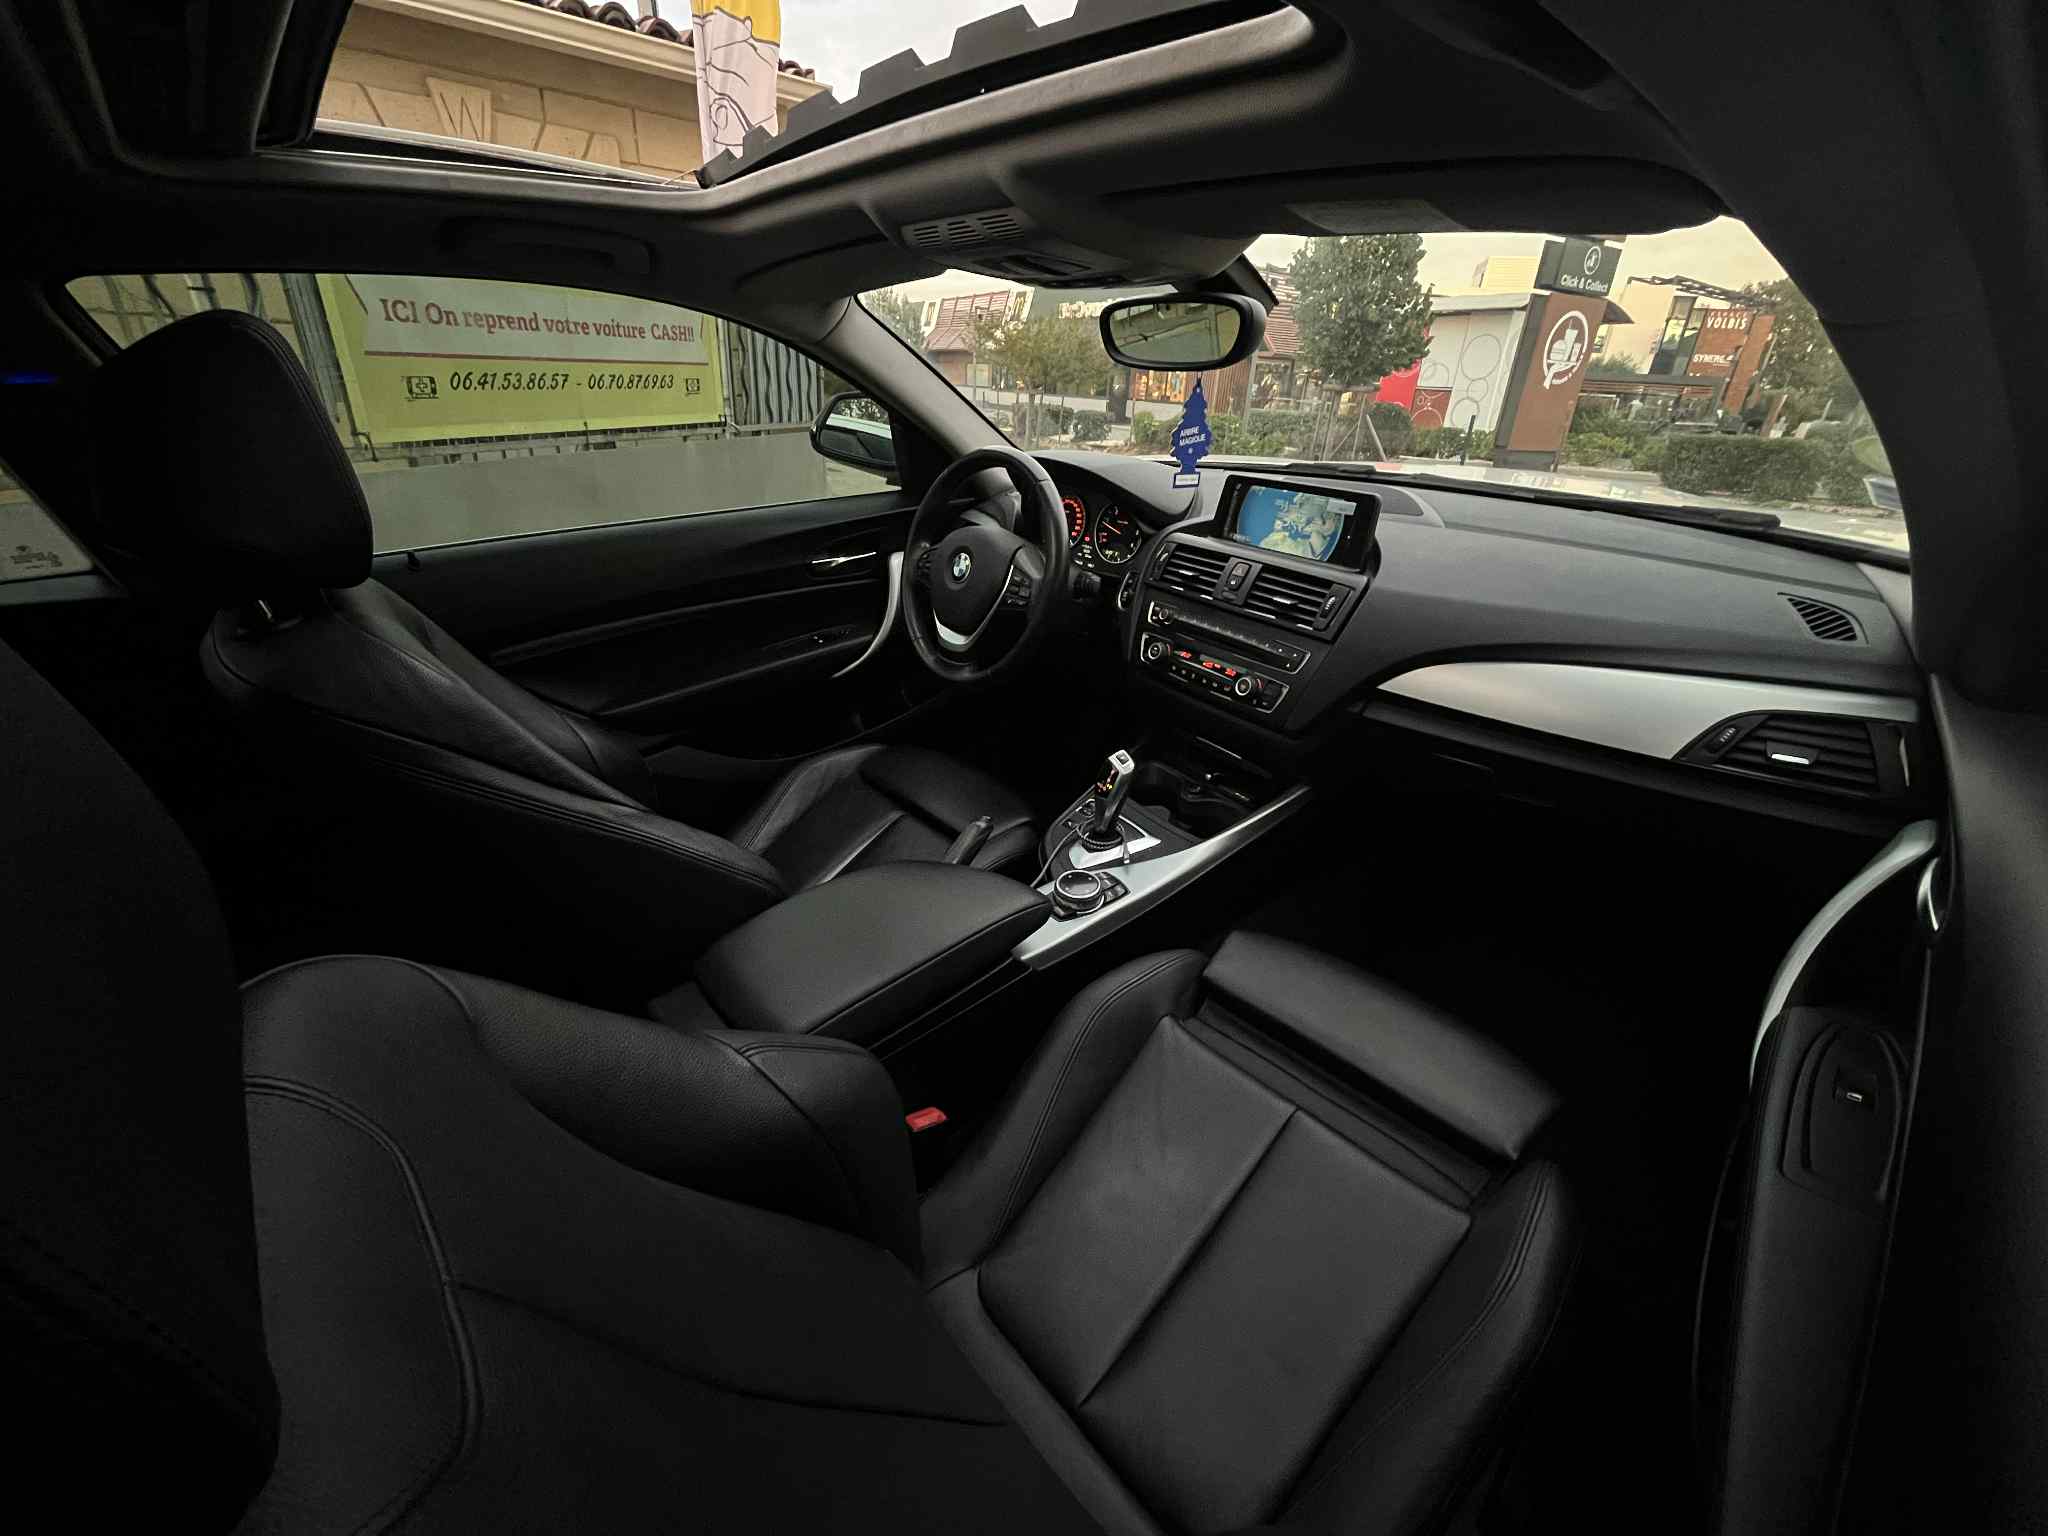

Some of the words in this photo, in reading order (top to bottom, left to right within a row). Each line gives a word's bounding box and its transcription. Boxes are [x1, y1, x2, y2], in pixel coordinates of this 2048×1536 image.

[379, 298, 420, 324] ICI
[425, 302, 459, 327] On
[463, 311, 541, 334] reprend
[543, 317, 590, 336] votre
[593, 319, 646, 340] voiture
[650, 323, 695, 343] CASH!!
[450, 372, 570, 391] 06.41.53.86.57
